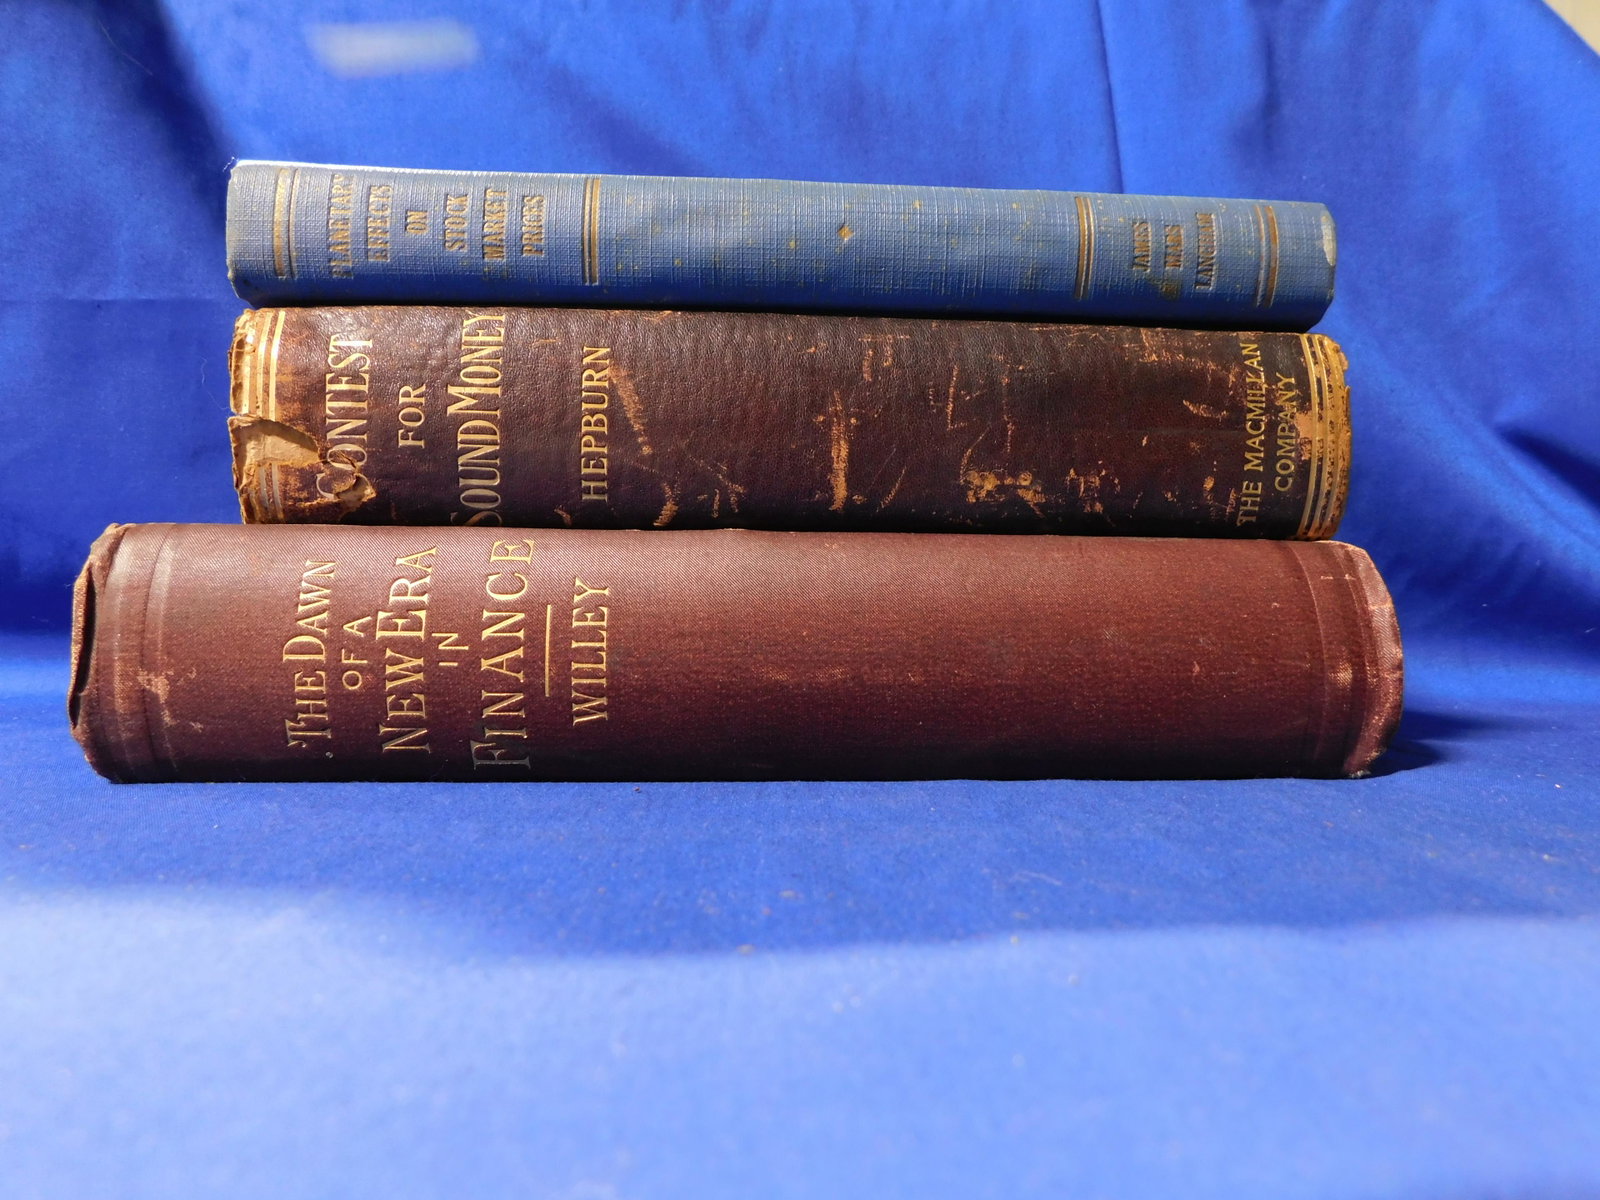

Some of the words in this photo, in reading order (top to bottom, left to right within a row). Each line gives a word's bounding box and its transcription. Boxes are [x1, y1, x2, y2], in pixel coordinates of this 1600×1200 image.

[367, 184, 393, 262] EFFECTS
[405, 210, 428, 235] ON
[444, 193, 469, 251] STOCK
[483, 187, 507, 260] MARKET
[521, 194, 546, 256] PRICES
[1132, 221, 1151, 272] JAMES
[1195, 212, 1216, 291] LANGHAM
[447, 310, 506, 418] MONEY
[398, 384, 426, 449] FOR
[581, 346, 611, 502] HEPBURN
[1240, 342, 1266, 472] MACMILLAN
[1275, 372, 1297, 492] COMPANY
[450, 419, 503, 526] SOUND
[1236, 480, 1262, 526] THE
[282, 559, 337, 663] DAWN
[342, 616, 372, 638] A
[376, 545, 438, 642] ERA
[341, 648, 369, 690] OF
[431, 632, 469, 667] IN
[470, 538, 536, 770] FINANCE
[571, 577, 610, 726] WILLEY
[284, 670, 331, 748] THE
[379, 647, 431, 754] NEW
